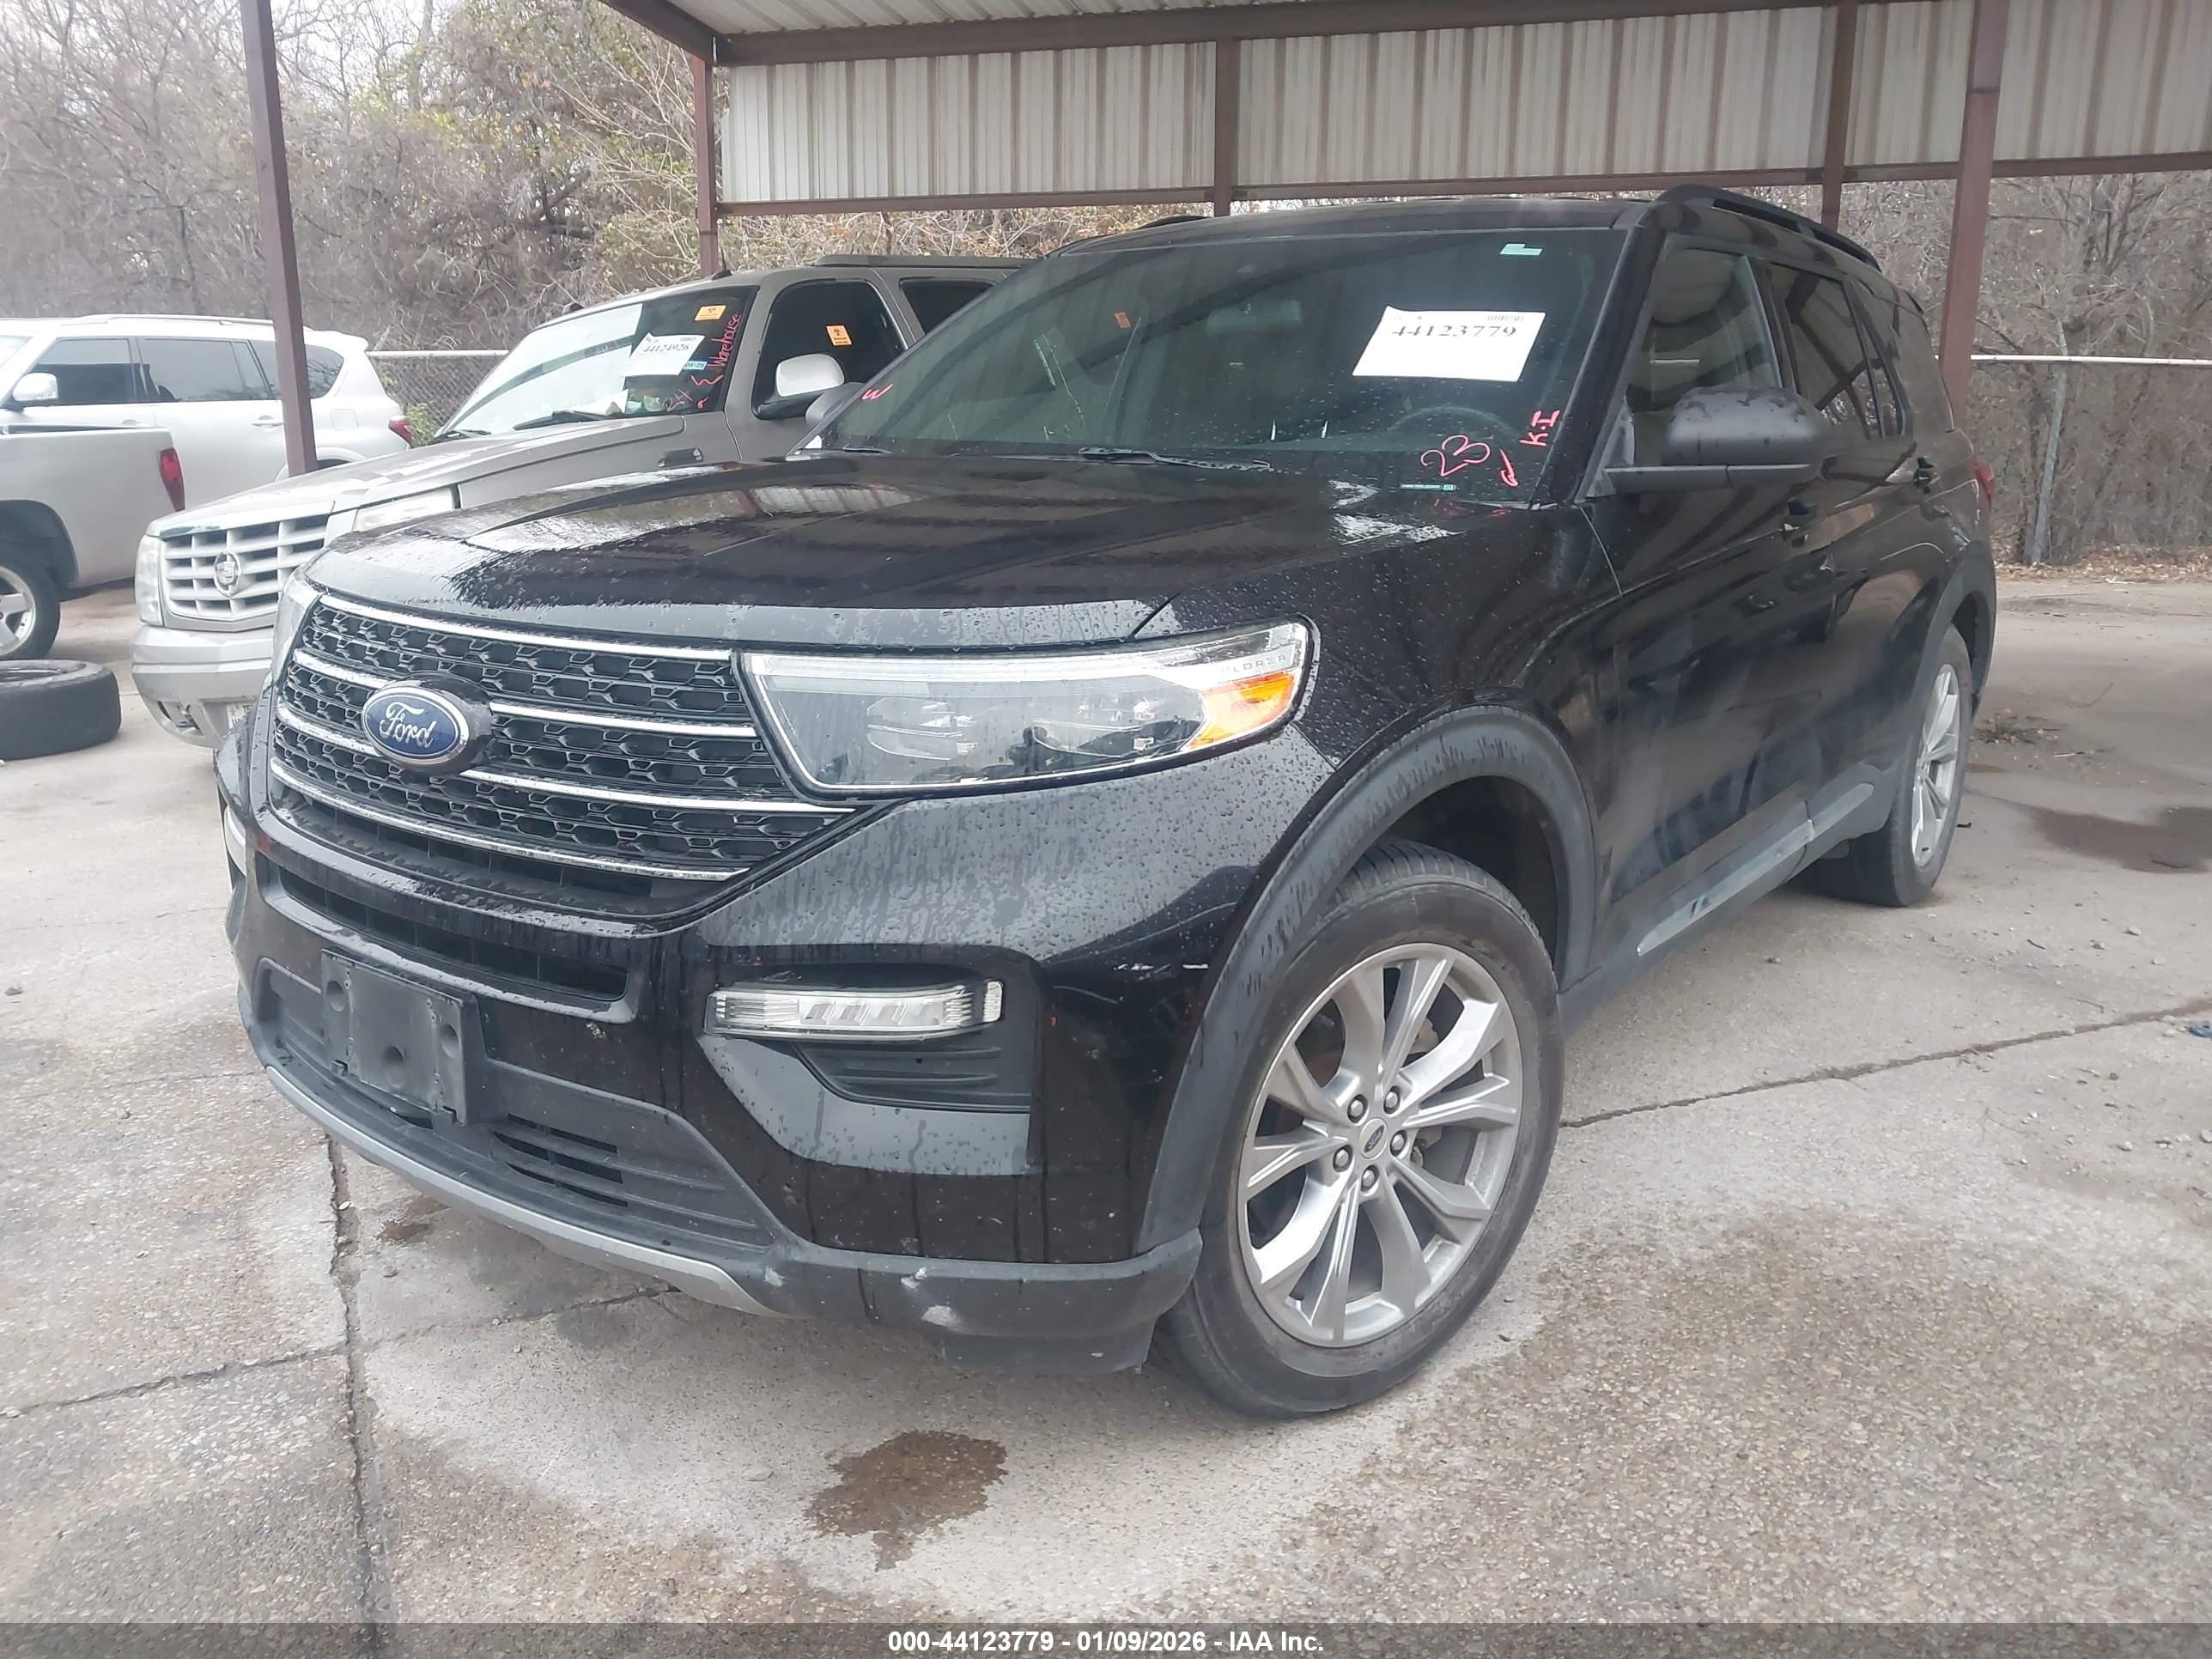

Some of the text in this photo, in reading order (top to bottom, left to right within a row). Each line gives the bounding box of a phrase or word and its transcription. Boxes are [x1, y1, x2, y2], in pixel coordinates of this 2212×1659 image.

[1392, 325, 1517, 337] 44123779
[1420, 434, 1491, 477] 23
[379, 702, 437, 748] Ford
